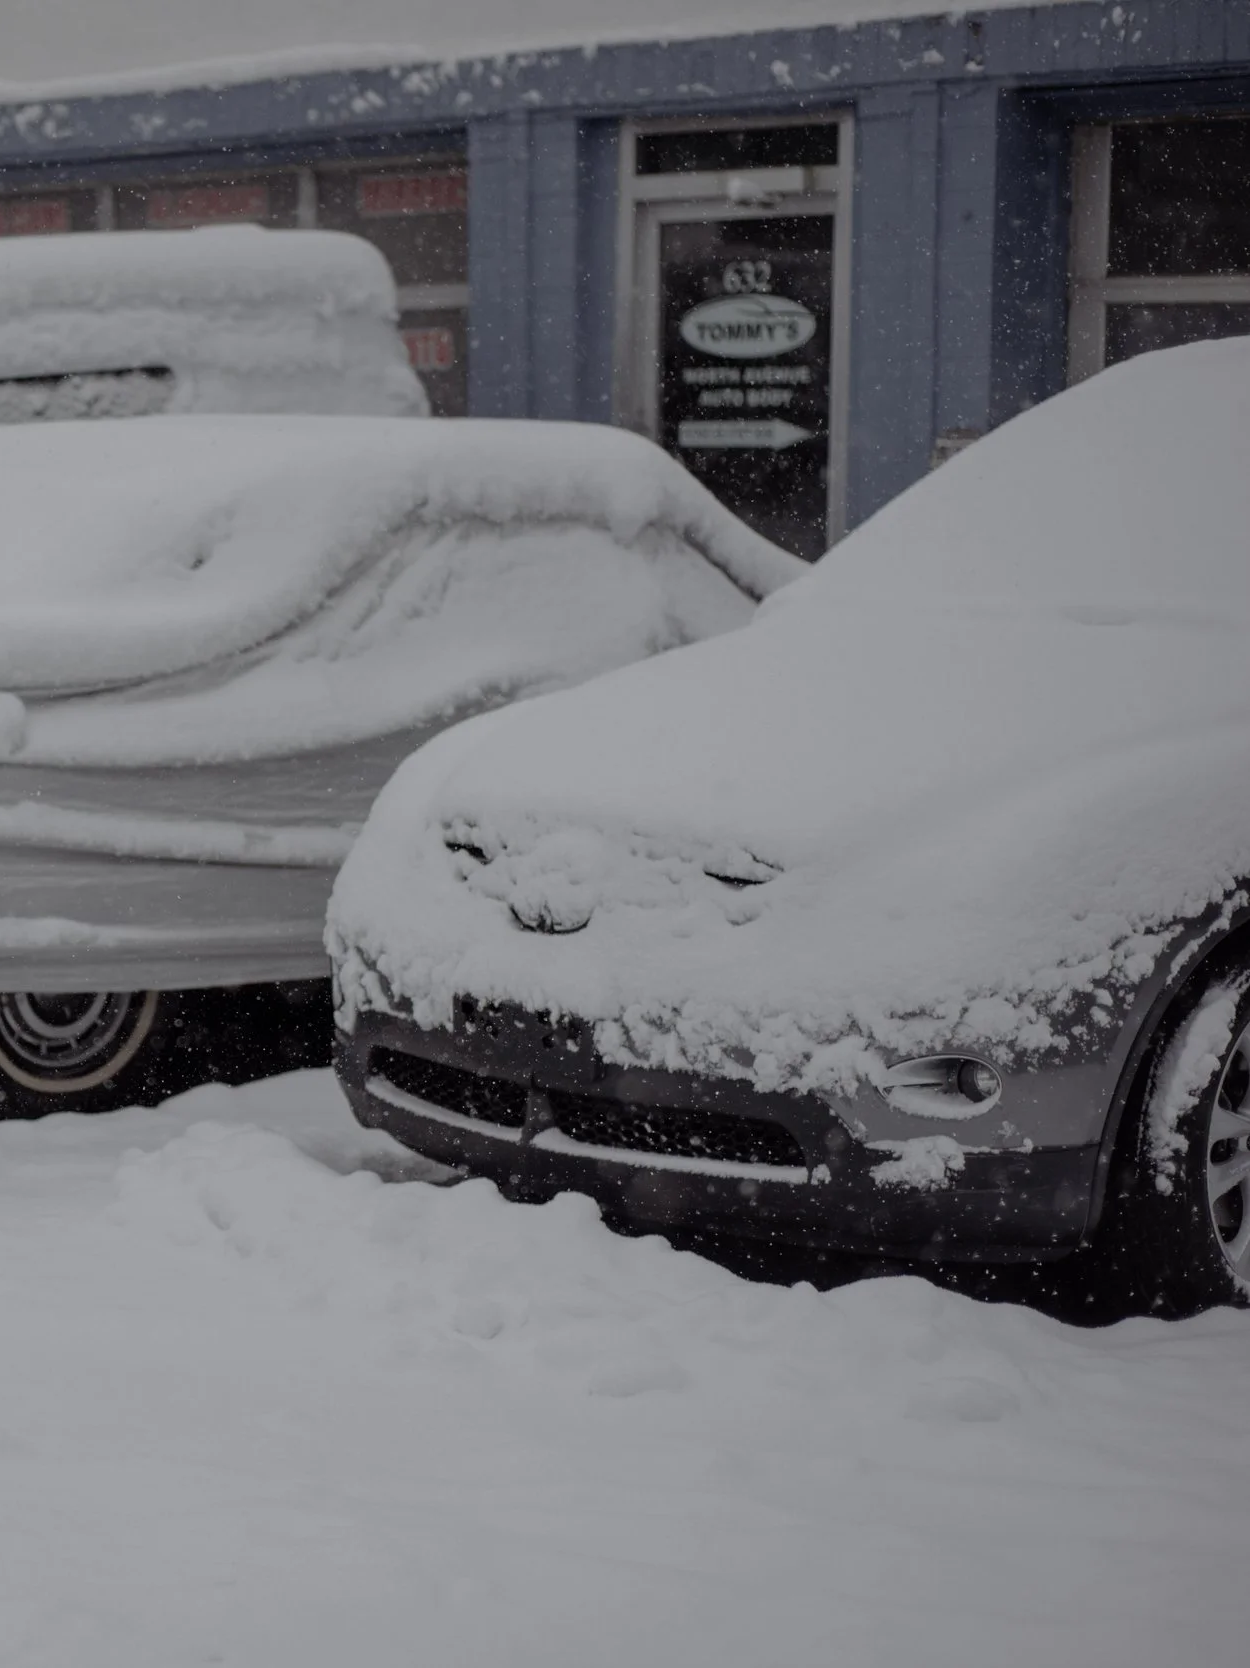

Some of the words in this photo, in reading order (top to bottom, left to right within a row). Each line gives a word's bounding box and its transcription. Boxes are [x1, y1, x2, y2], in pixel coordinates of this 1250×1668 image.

[724, 260, 773, 292] 632
[697, 321, 798, 341] TOMMY'S
[743, 365, 812, 384] AVENUE
[698, 388, 744, 408] AUTO
[746, 388, 794, 408] BODY
